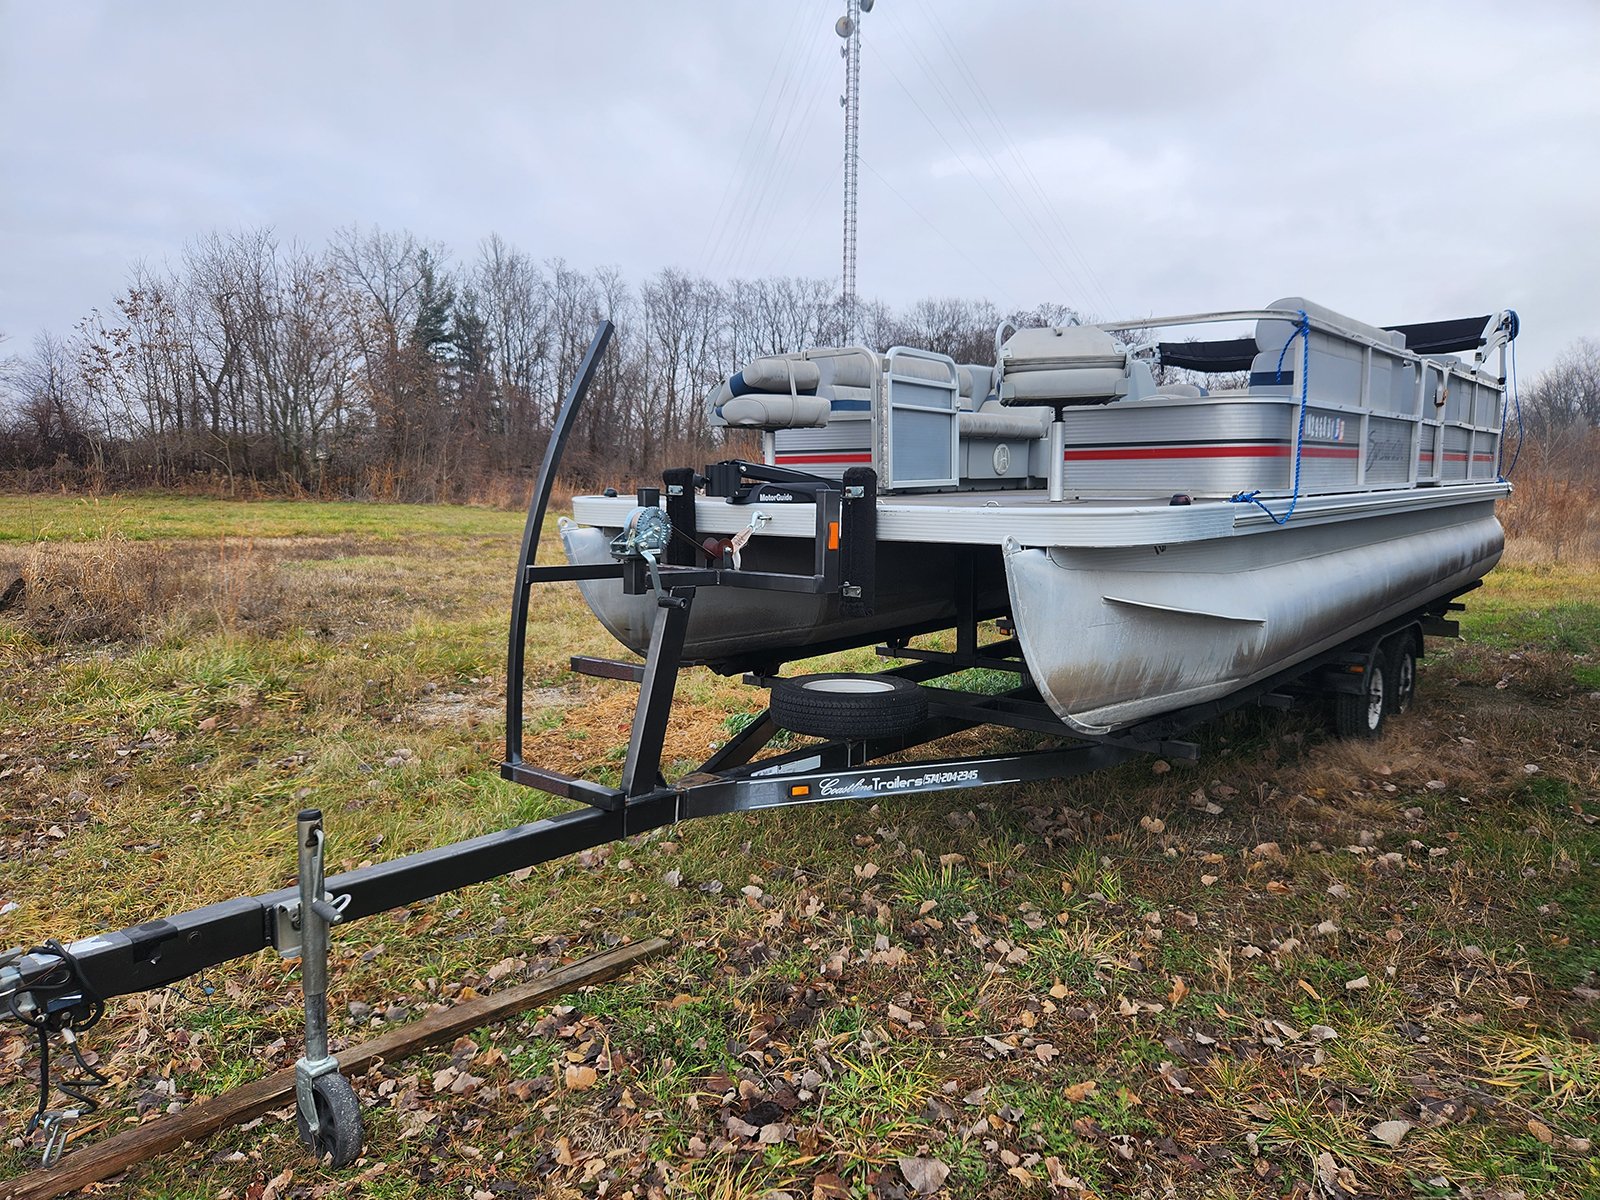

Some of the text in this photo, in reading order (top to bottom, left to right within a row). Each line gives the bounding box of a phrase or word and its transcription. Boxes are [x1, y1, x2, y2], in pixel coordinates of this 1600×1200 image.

[760, 493, 793, 502] MotorGuide
[818, 778, 873, 796] Coastline
[872, 776, 923, 791] Trailers
